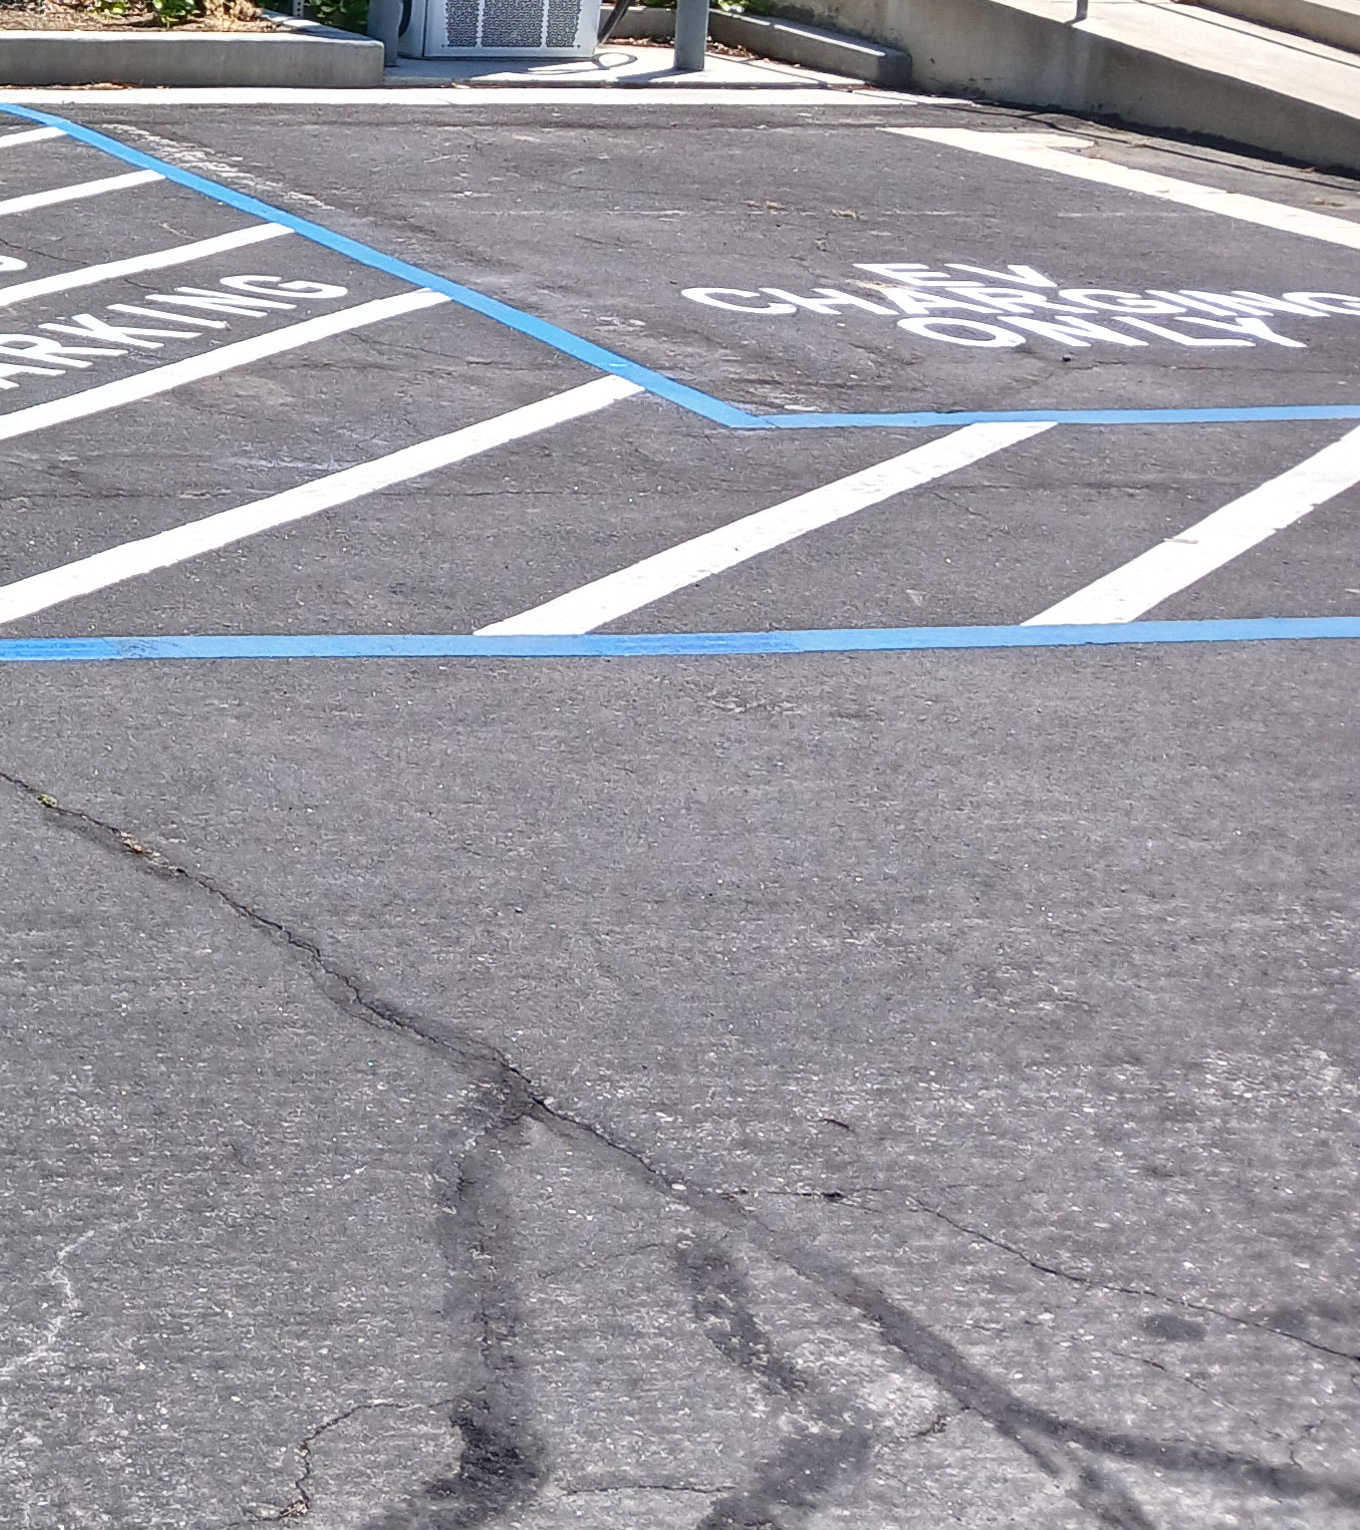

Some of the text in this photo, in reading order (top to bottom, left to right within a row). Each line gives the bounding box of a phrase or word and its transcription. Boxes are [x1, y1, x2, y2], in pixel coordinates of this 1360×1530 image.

[853, 262, 1058, 289] EV
[680, 287, 1360, 318] CHARGING
[896, 316, 1309, 348] ONLY
